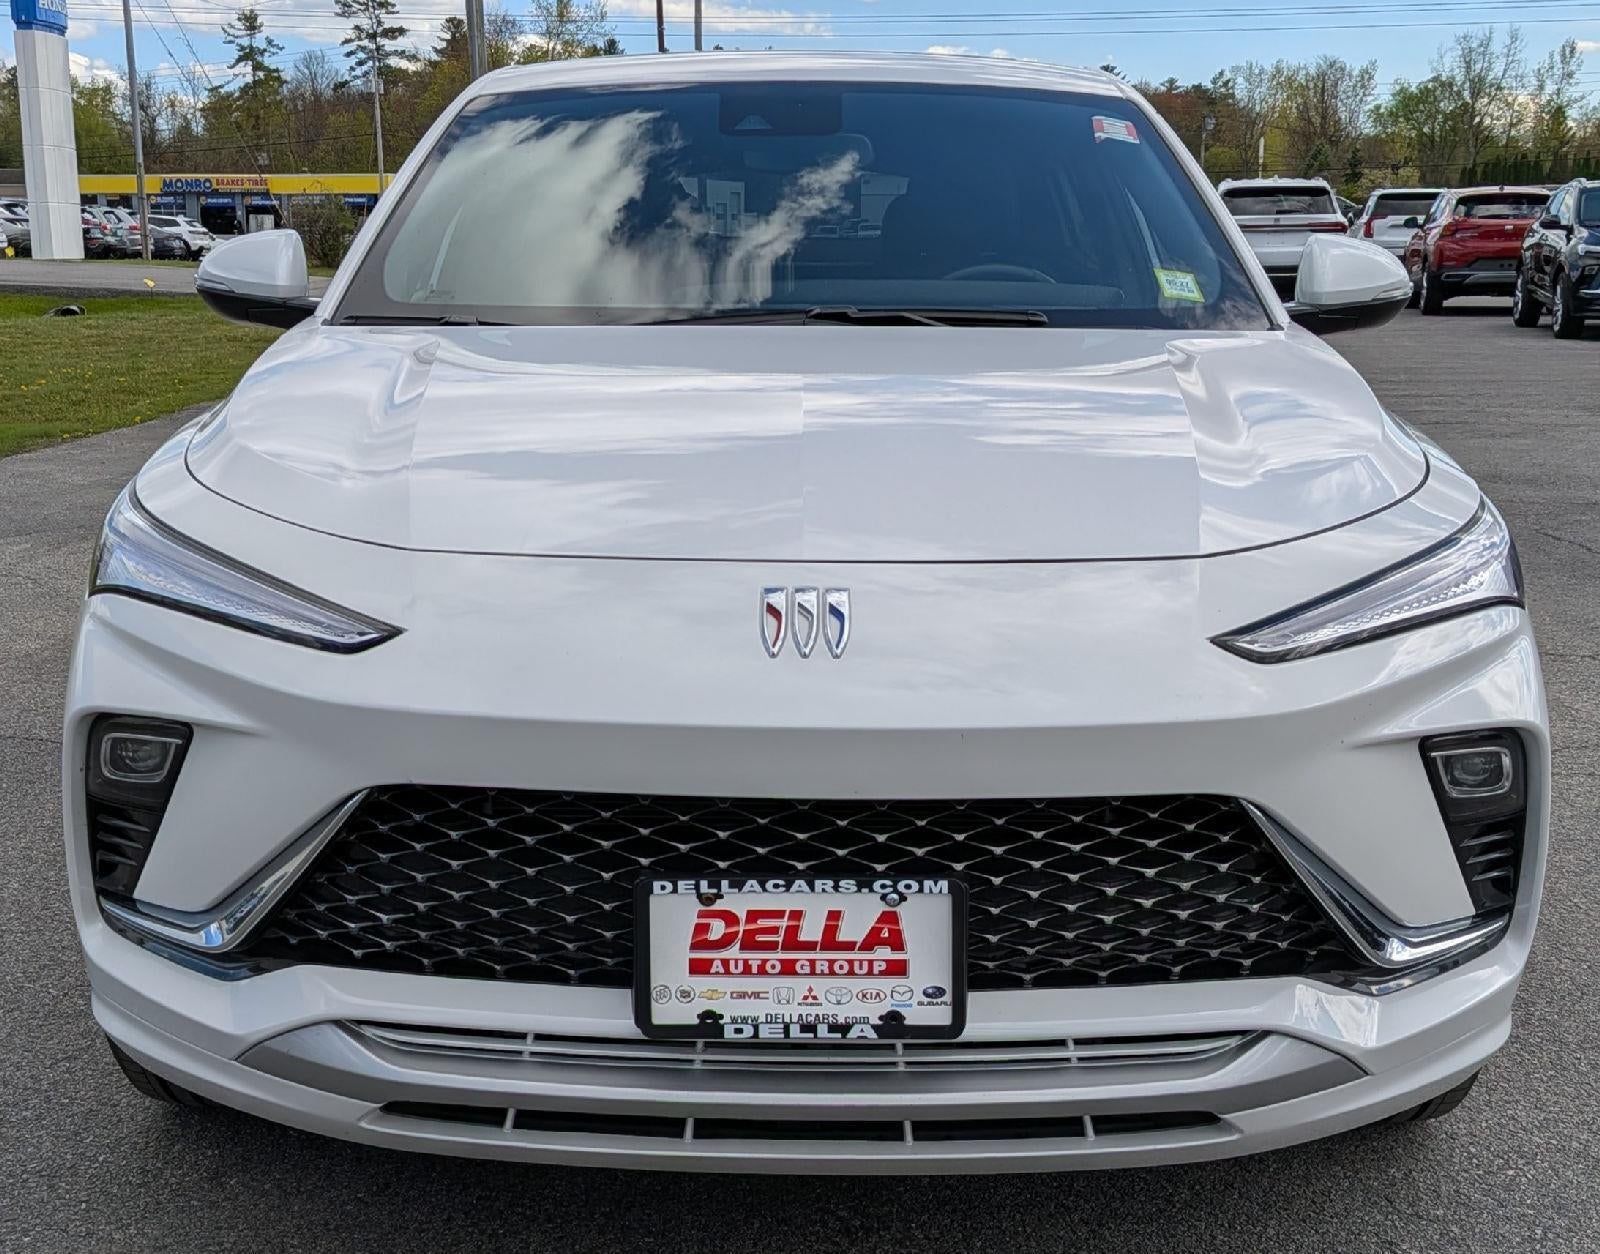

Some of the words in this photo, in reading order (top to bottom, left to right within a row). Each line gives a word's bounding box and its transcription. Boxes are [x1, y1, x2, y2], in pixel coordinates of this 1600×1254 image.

[162, 177, 213, 192] MONRO
[652, 879, 949, 895] DELLACARS.COM
[688, 908, 908, 955] DELLA
[709, 959, 782, 975] AUTO
[795, 959, 888, 976] GROUP
[730, 990, 770, 1001] GMC
[861, 991, 882, 1001] KIA
[723, 1023, 879, 1039] DELLA
